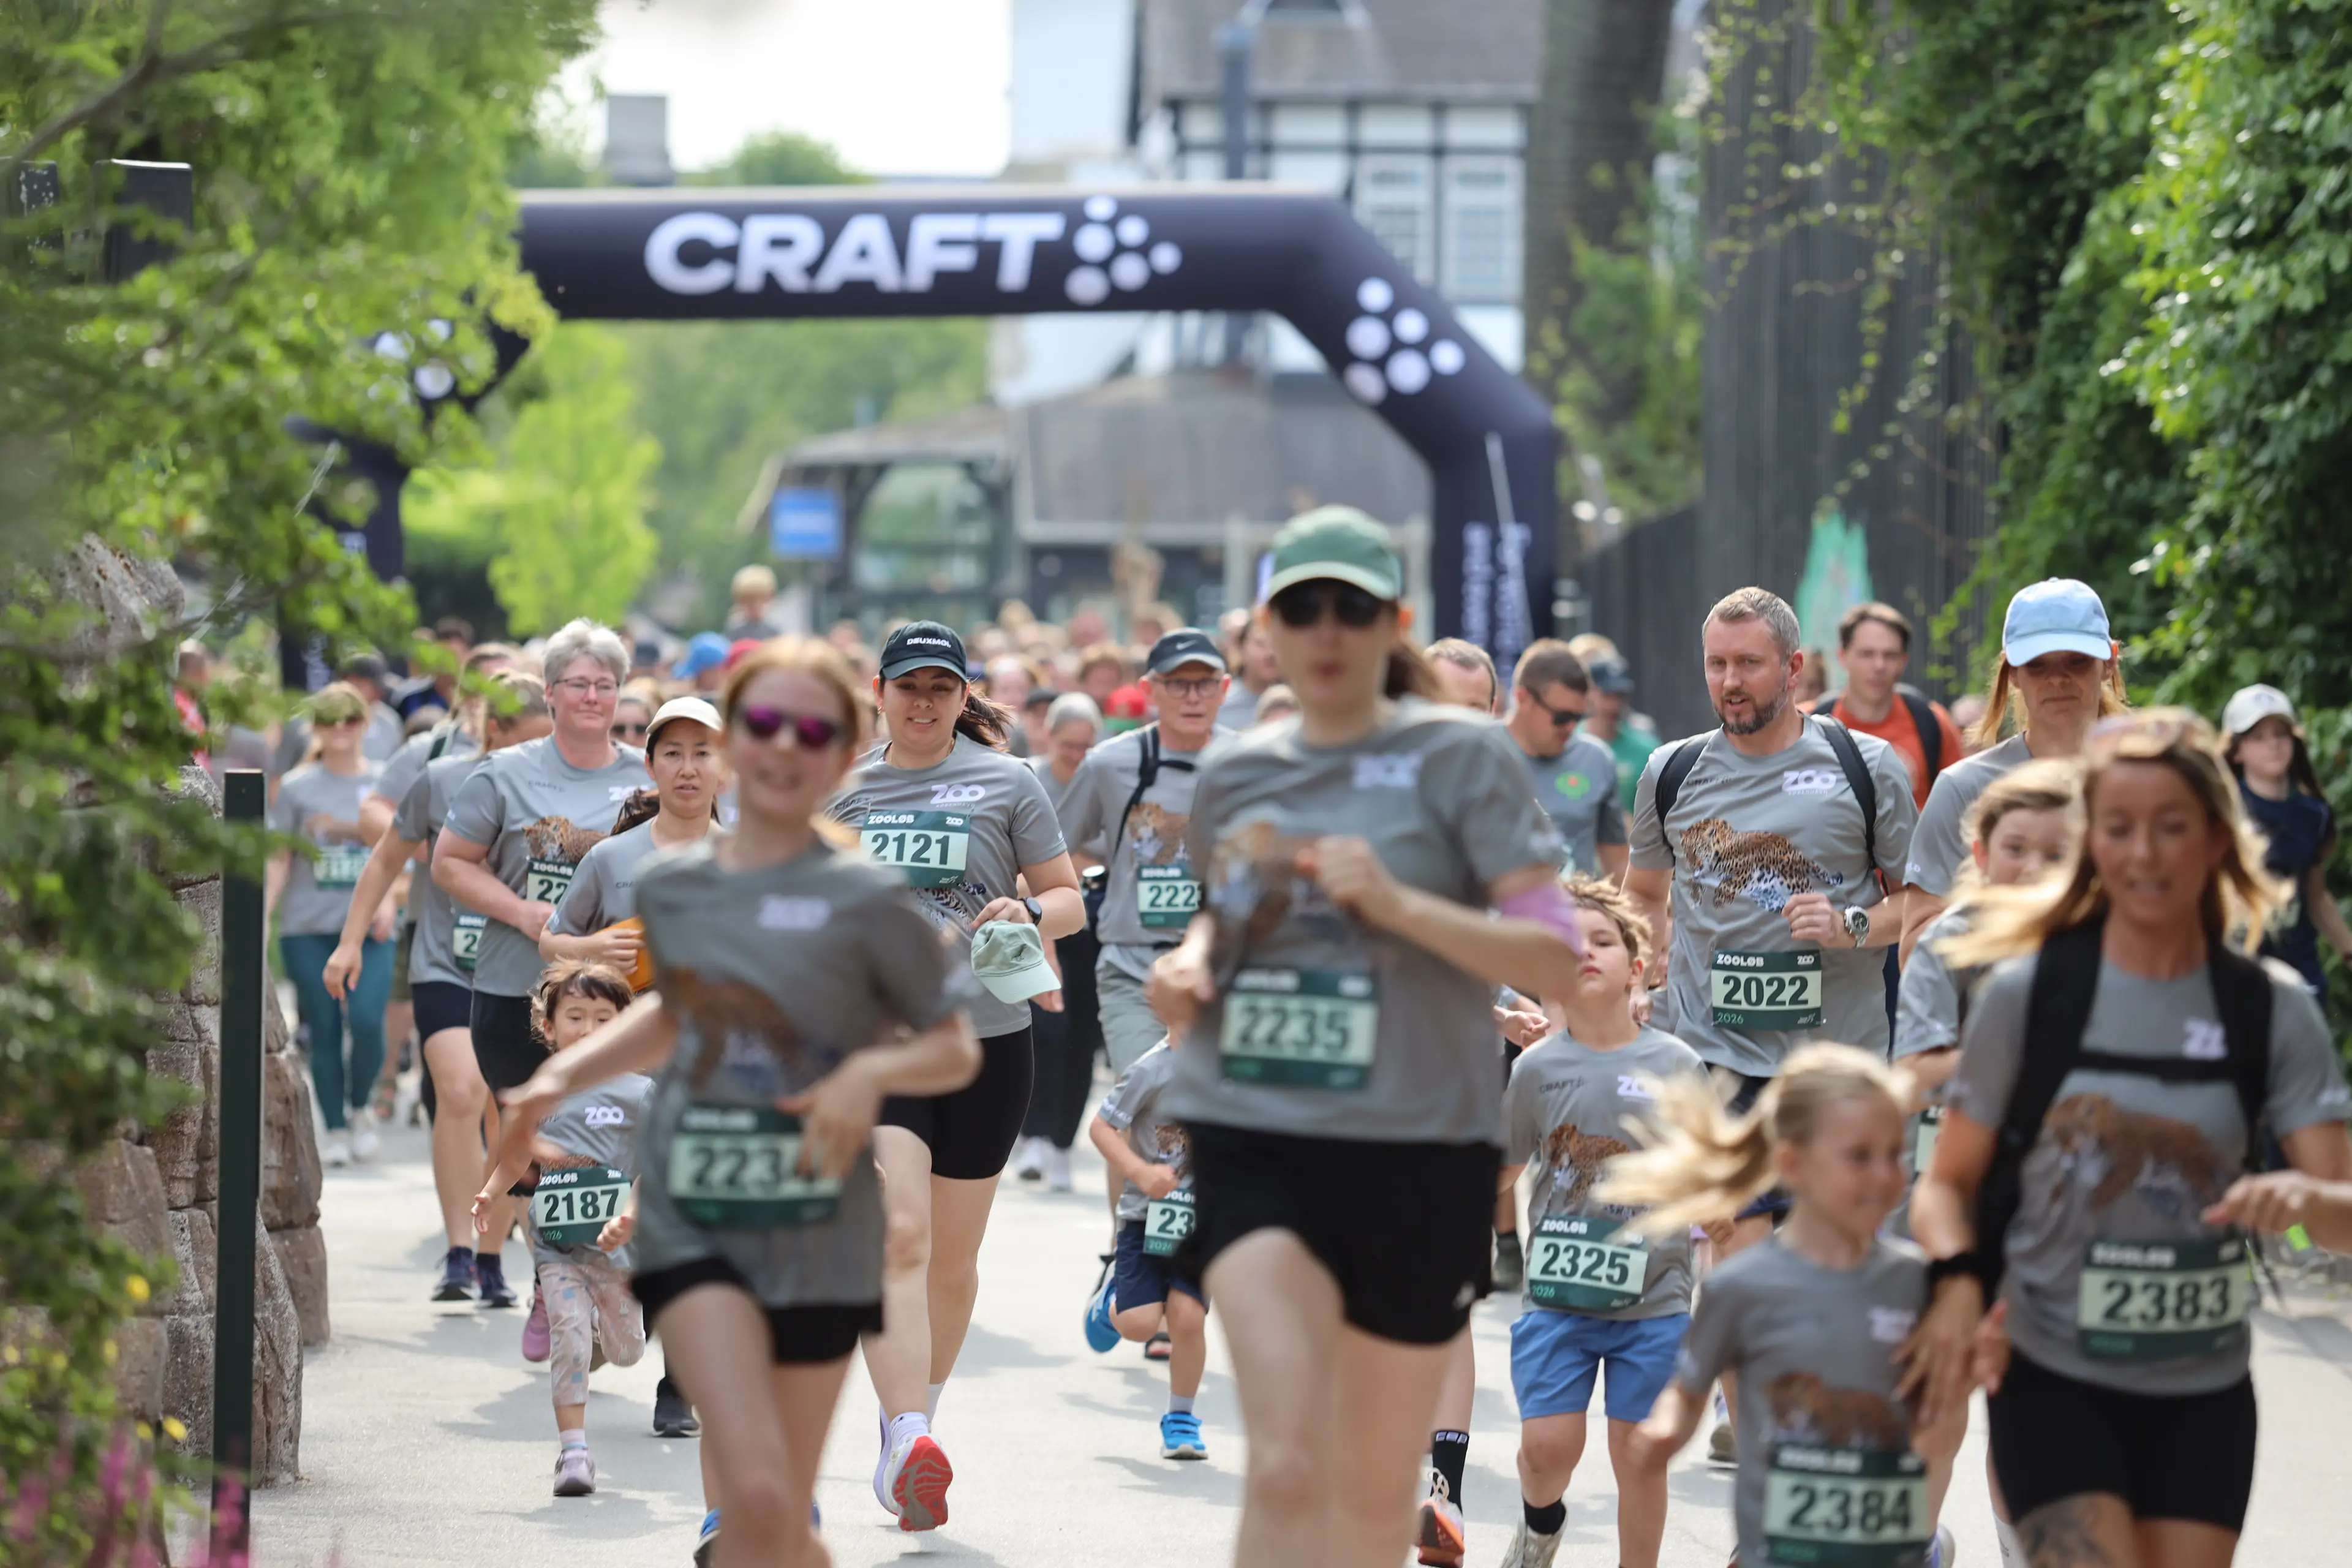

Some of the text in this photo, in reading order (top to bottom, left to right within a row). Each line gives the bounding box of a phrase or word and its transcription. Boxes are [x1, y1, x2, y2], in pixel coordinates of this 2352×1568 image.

[644, 212, 1066, 295] CRAFT
[930, 784, 986, 804] ZOO
[1782, 769, 1836, 791] ZOO
[868, 814, 914, 824] ZOOLØB
[946, 816, 963, 826] ZOO
[871, 833, 949, 865] 2121
[537, 878, 568, 905] 22
[1149, 884, 1202, 907] 222
[1717, 954, 1764, 967] ZOOLØB
[1797, 956, 1814, 965] ZOO
[1723, 975, 1809, 1006] 2022
[1237, 1005, 1351, 1051] 2235
[1717, 1012, 1744, 1025] 2026
[585, 1106, 624, 1125] ZOO
[687, 1147, 816, 1191] 223
[544, 1188, 619, 1223] 2187
[1157, 1208, 1194, 1237] 23
[1540, 1242, 1630, 1286] 2325
[2102, 1276, 2230, 1323] 2383
[1787, 1483, 1912, 1533] 2384
